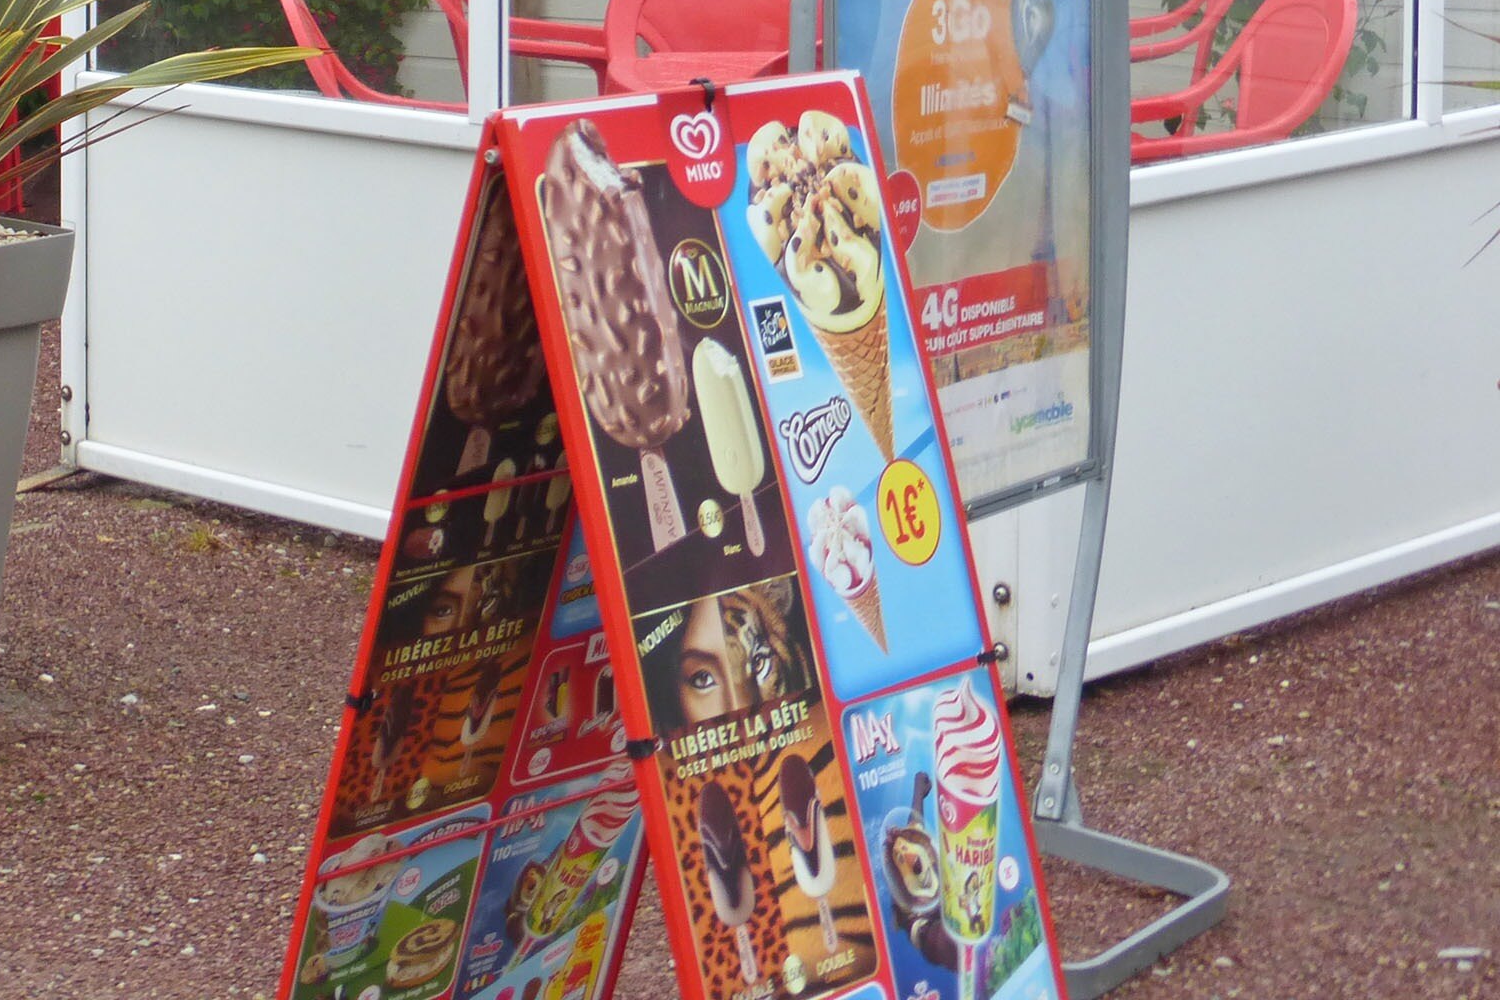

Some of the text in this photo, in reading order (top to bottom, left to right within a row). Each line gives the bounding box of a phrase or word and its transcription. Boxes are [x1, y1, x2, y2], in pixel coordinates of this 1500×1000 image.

[684, 163, 722, 183] MIKO
[684, 297, 725, 315] MAGNUM
[921, 288, 1015, 331] 4G DISPONIBLE
[968, 311, 1045, 342] SUPPLÉMENTAIRE
[780, 396, 852, 484] Cornetto
[384, 618, 525, 667] LIBÉREZ LA BÊTE
[638, 609, 684, 659] NOUVEAU
[381, 667, 411, 683] OSEZ
[415, 653, 471, 676] MAGNUM
[671, 699, 810, 761] LIBÉREZ LA BÊTE
[850, 709, 901, 766] MAX
[676, 725, 814, 781] OSEZ MAGNUM DOUBLE
[858, 767, 879, 792] 110
[816, 948, 856, 976] DOUBLE
